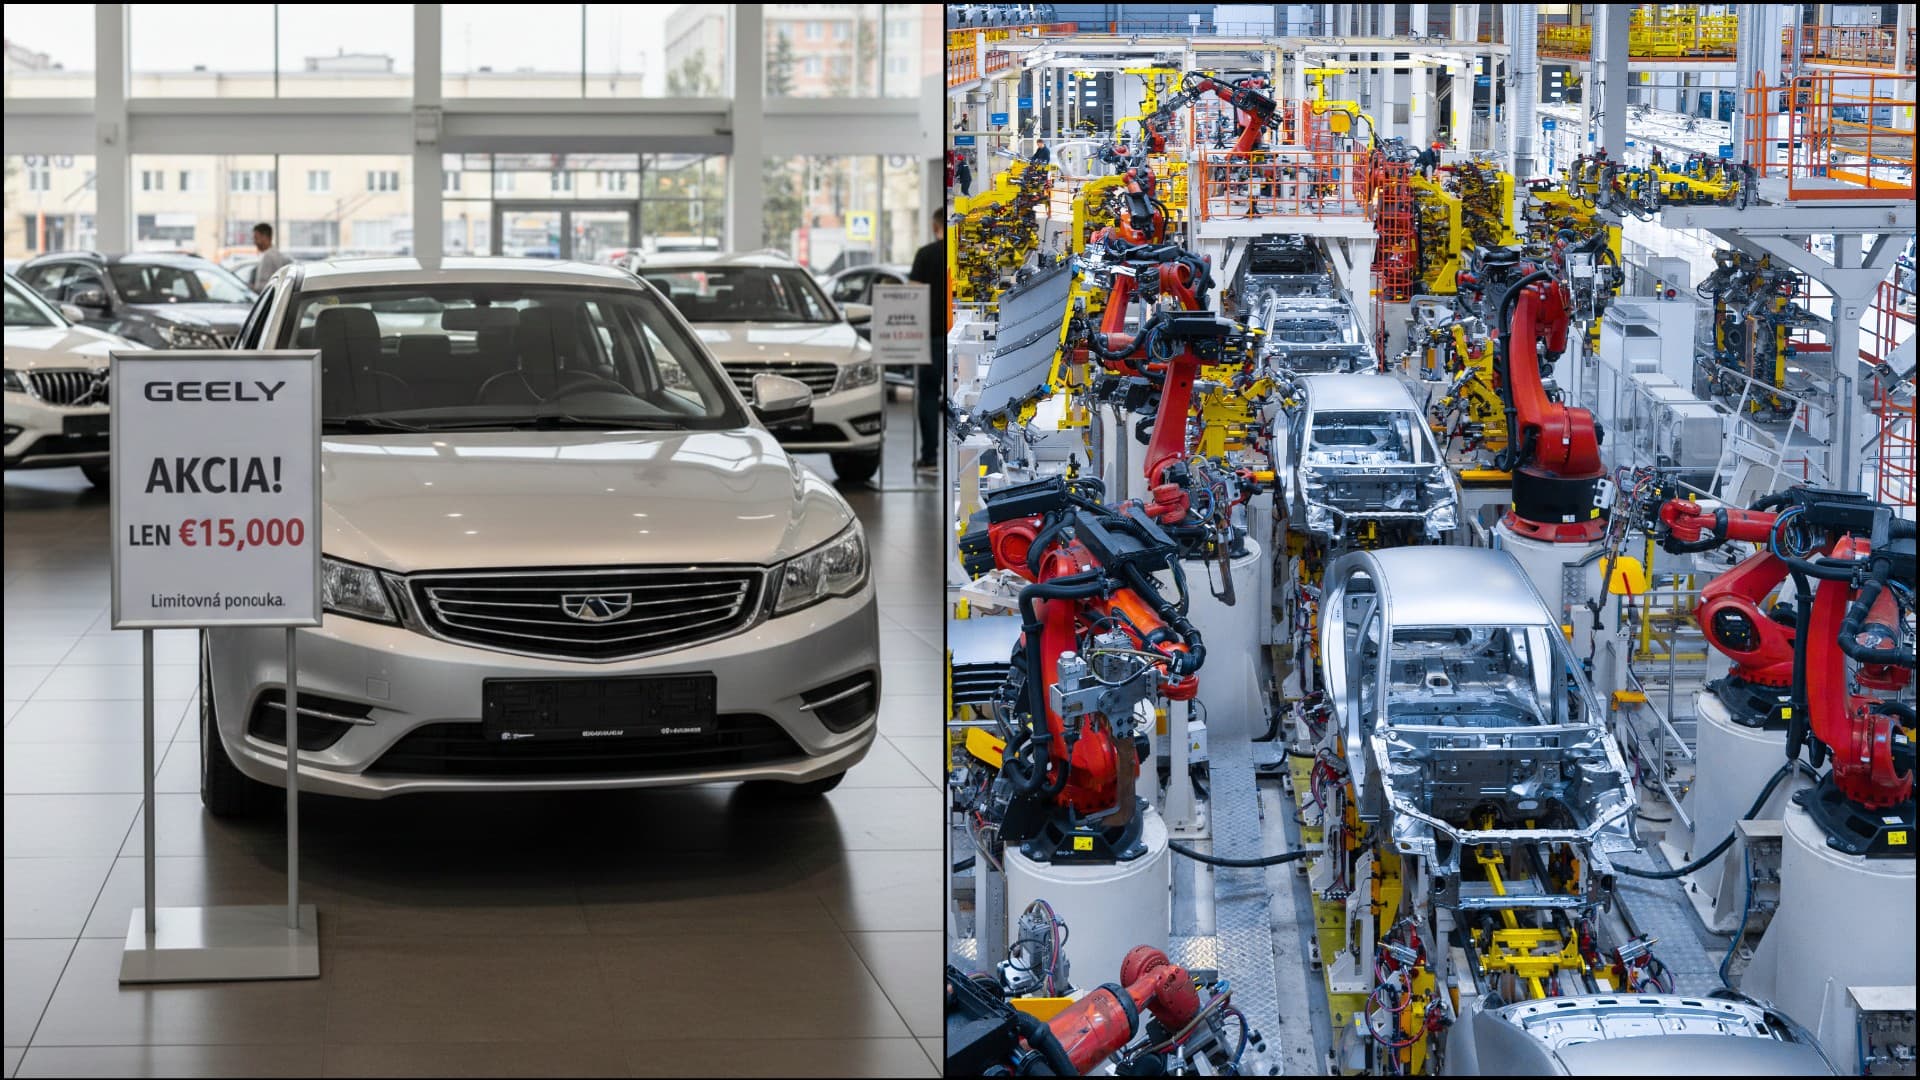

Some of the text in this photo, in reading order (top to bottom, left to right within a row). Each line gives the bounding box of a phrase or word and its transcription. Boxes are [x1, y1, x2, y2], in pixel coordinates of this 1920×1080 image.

[144, 381, 286, 402] GEELY
[144, 456, 283, 494] AKCIA!
[129, 518, 305, 552] LEN €15,000
[151, 592, 221, 608] Limitovná
